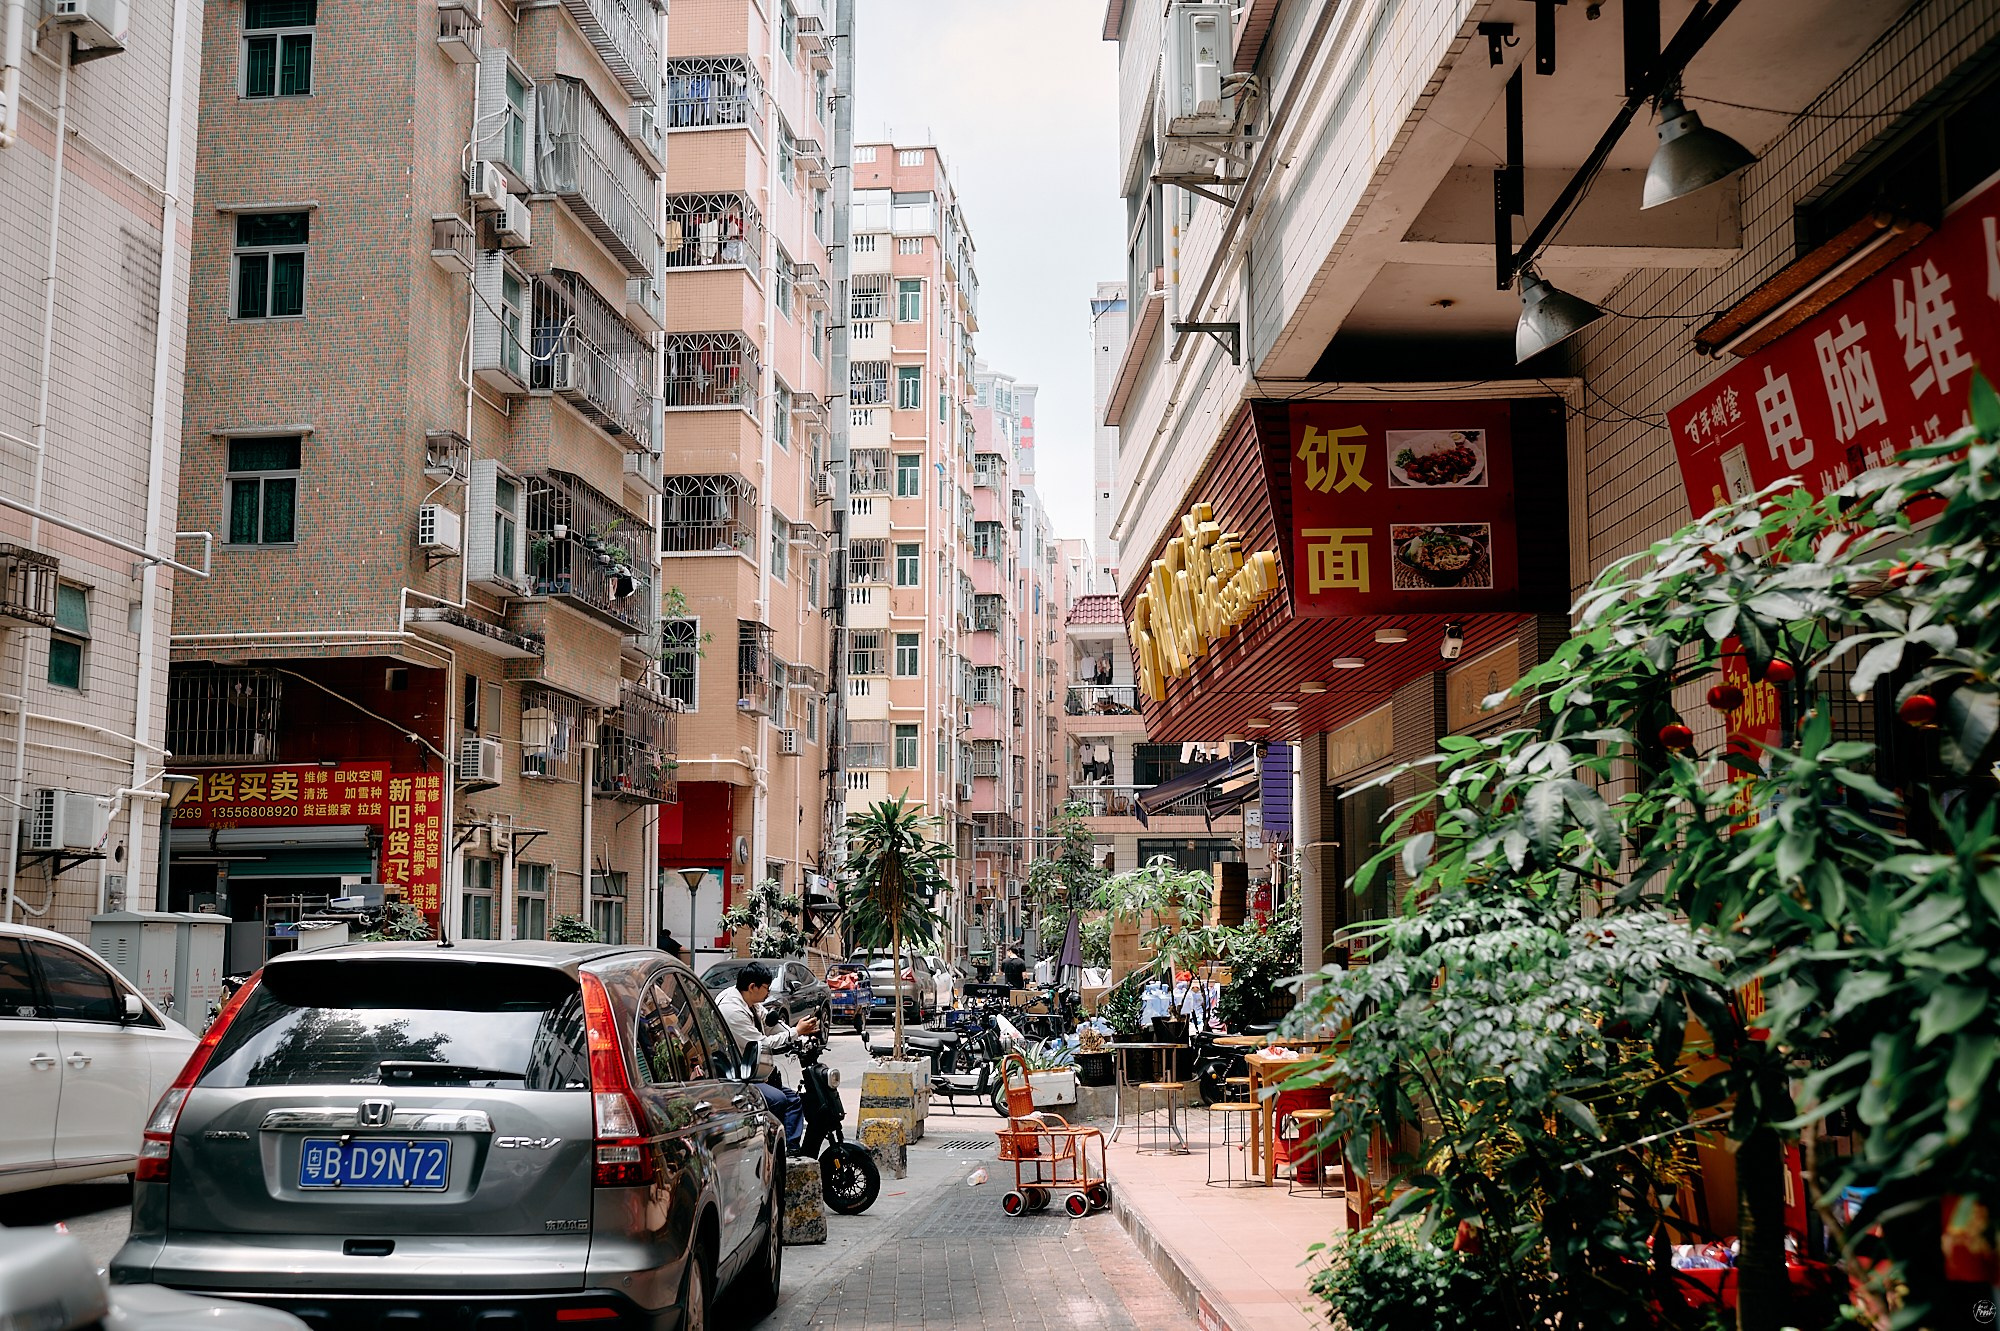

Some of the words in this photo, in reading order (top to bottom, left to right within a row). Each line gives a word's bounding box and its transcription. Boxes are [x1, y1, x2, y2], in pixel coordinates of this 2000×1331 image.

[1755, 217, 2000, 470] 电脑维
[1296, 424, 1373, 494] 饭
[1301, 527, 1373, 594] 面
[304, 771, 328, 783] 维修
[334, 769, 382, 783] 回收空调
[427, 776, 439, 802] 维修
[303, 787, 328, 800] 清洗
[345, 786, 382, 799] 加雪种
[415, 776, 426, 816] 加雪种
[211, 806, 298, 818] 13556808920
[303, 803, 351, 816] 货运搬家
[357, 803, 382, 816] 拉货
[413, 823, 425, 876] 货运搬家
[426, 816, 439, 869] 回收空调
[412, 883, 424, 909] 拉货
[425, 883, 437, 909] 清洗
[494, 1136, 561, 1149] CR-V
